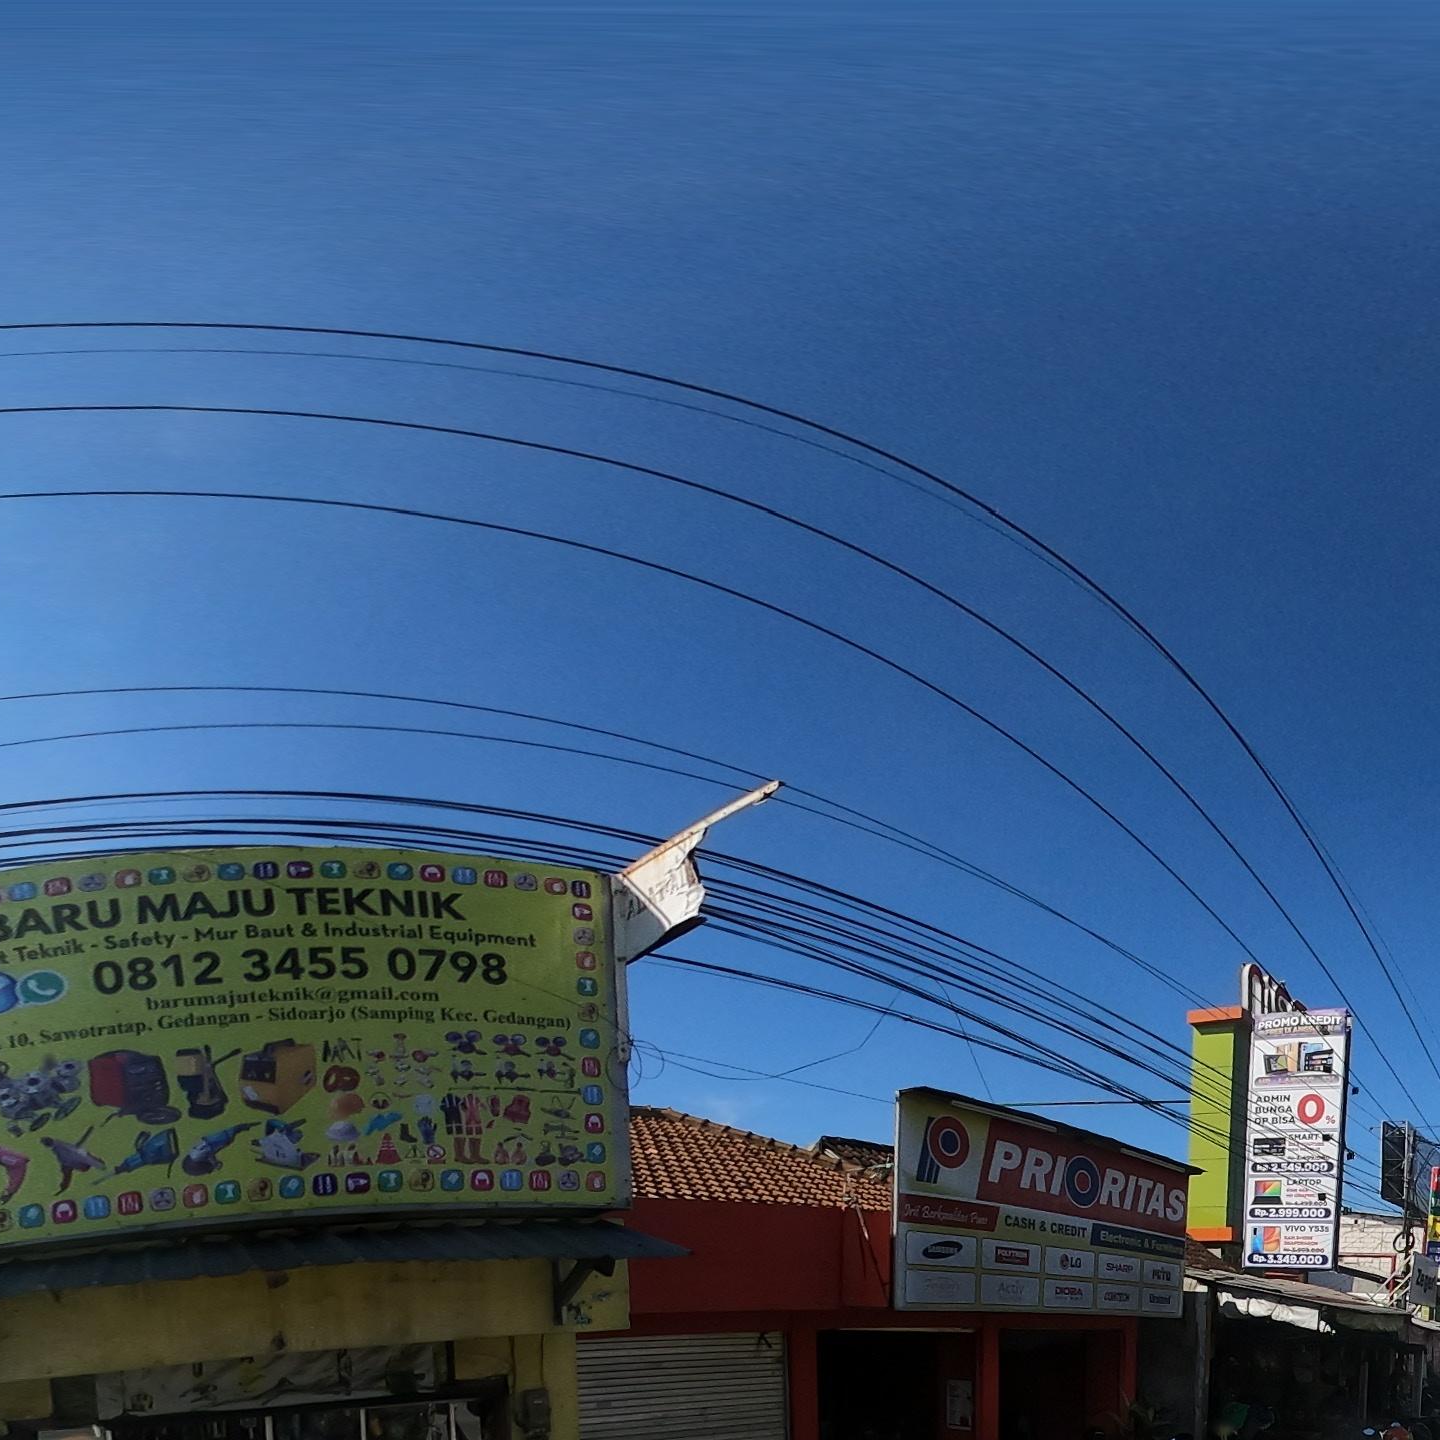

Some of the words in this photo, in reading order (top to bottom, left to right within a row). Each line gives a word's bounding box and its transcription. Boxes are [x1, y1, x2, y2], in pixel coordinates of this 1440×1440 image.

[137, 888, 275, 926] MAJU
[286, 887, 466, 921] TEKNIK
[13, 939, 85, 963] Teknik
[104, 931, 176, 951] Safety
[194, 926, 238, 943] Mur
[245, 923, 295, 940] Baut
[300, 921, 318, 938] &
[323, 920, 423, 941] Industrial
[429, 924, 537, 949] Equipment
[93, 950, 224, 996] 0812
[241, 946, 369, 982] 3455
[387, 946, 508, 986] 0798
[146, 986, 440, 1010] barumajuteknik@gmail.com
[157, 1010, 251, 1031] Gedangan
[267, 1006, 346, 1024] Sidoarjo
[351, 1006, 435, 1025] (Samping
[440, 1006, 478, 1024] Kec.
[482, 1008, 572, 1032] Gedangan)
[1257, 1016, 1300, 1030] PROMO
[1255, 1094, 1291, 1103] ADMIN
[987, 1139, 1186, 1221] PRIORITAS
[1004, 1213, 1036, 1231] CASH
[1038, 1221, 1047, 1232] &
[1050, 1221, 1088, 1239] CREDIT
[1284, 1225, 1307, 1233] VIVO
[1105, 1262, 1134, 1274] SHARP
